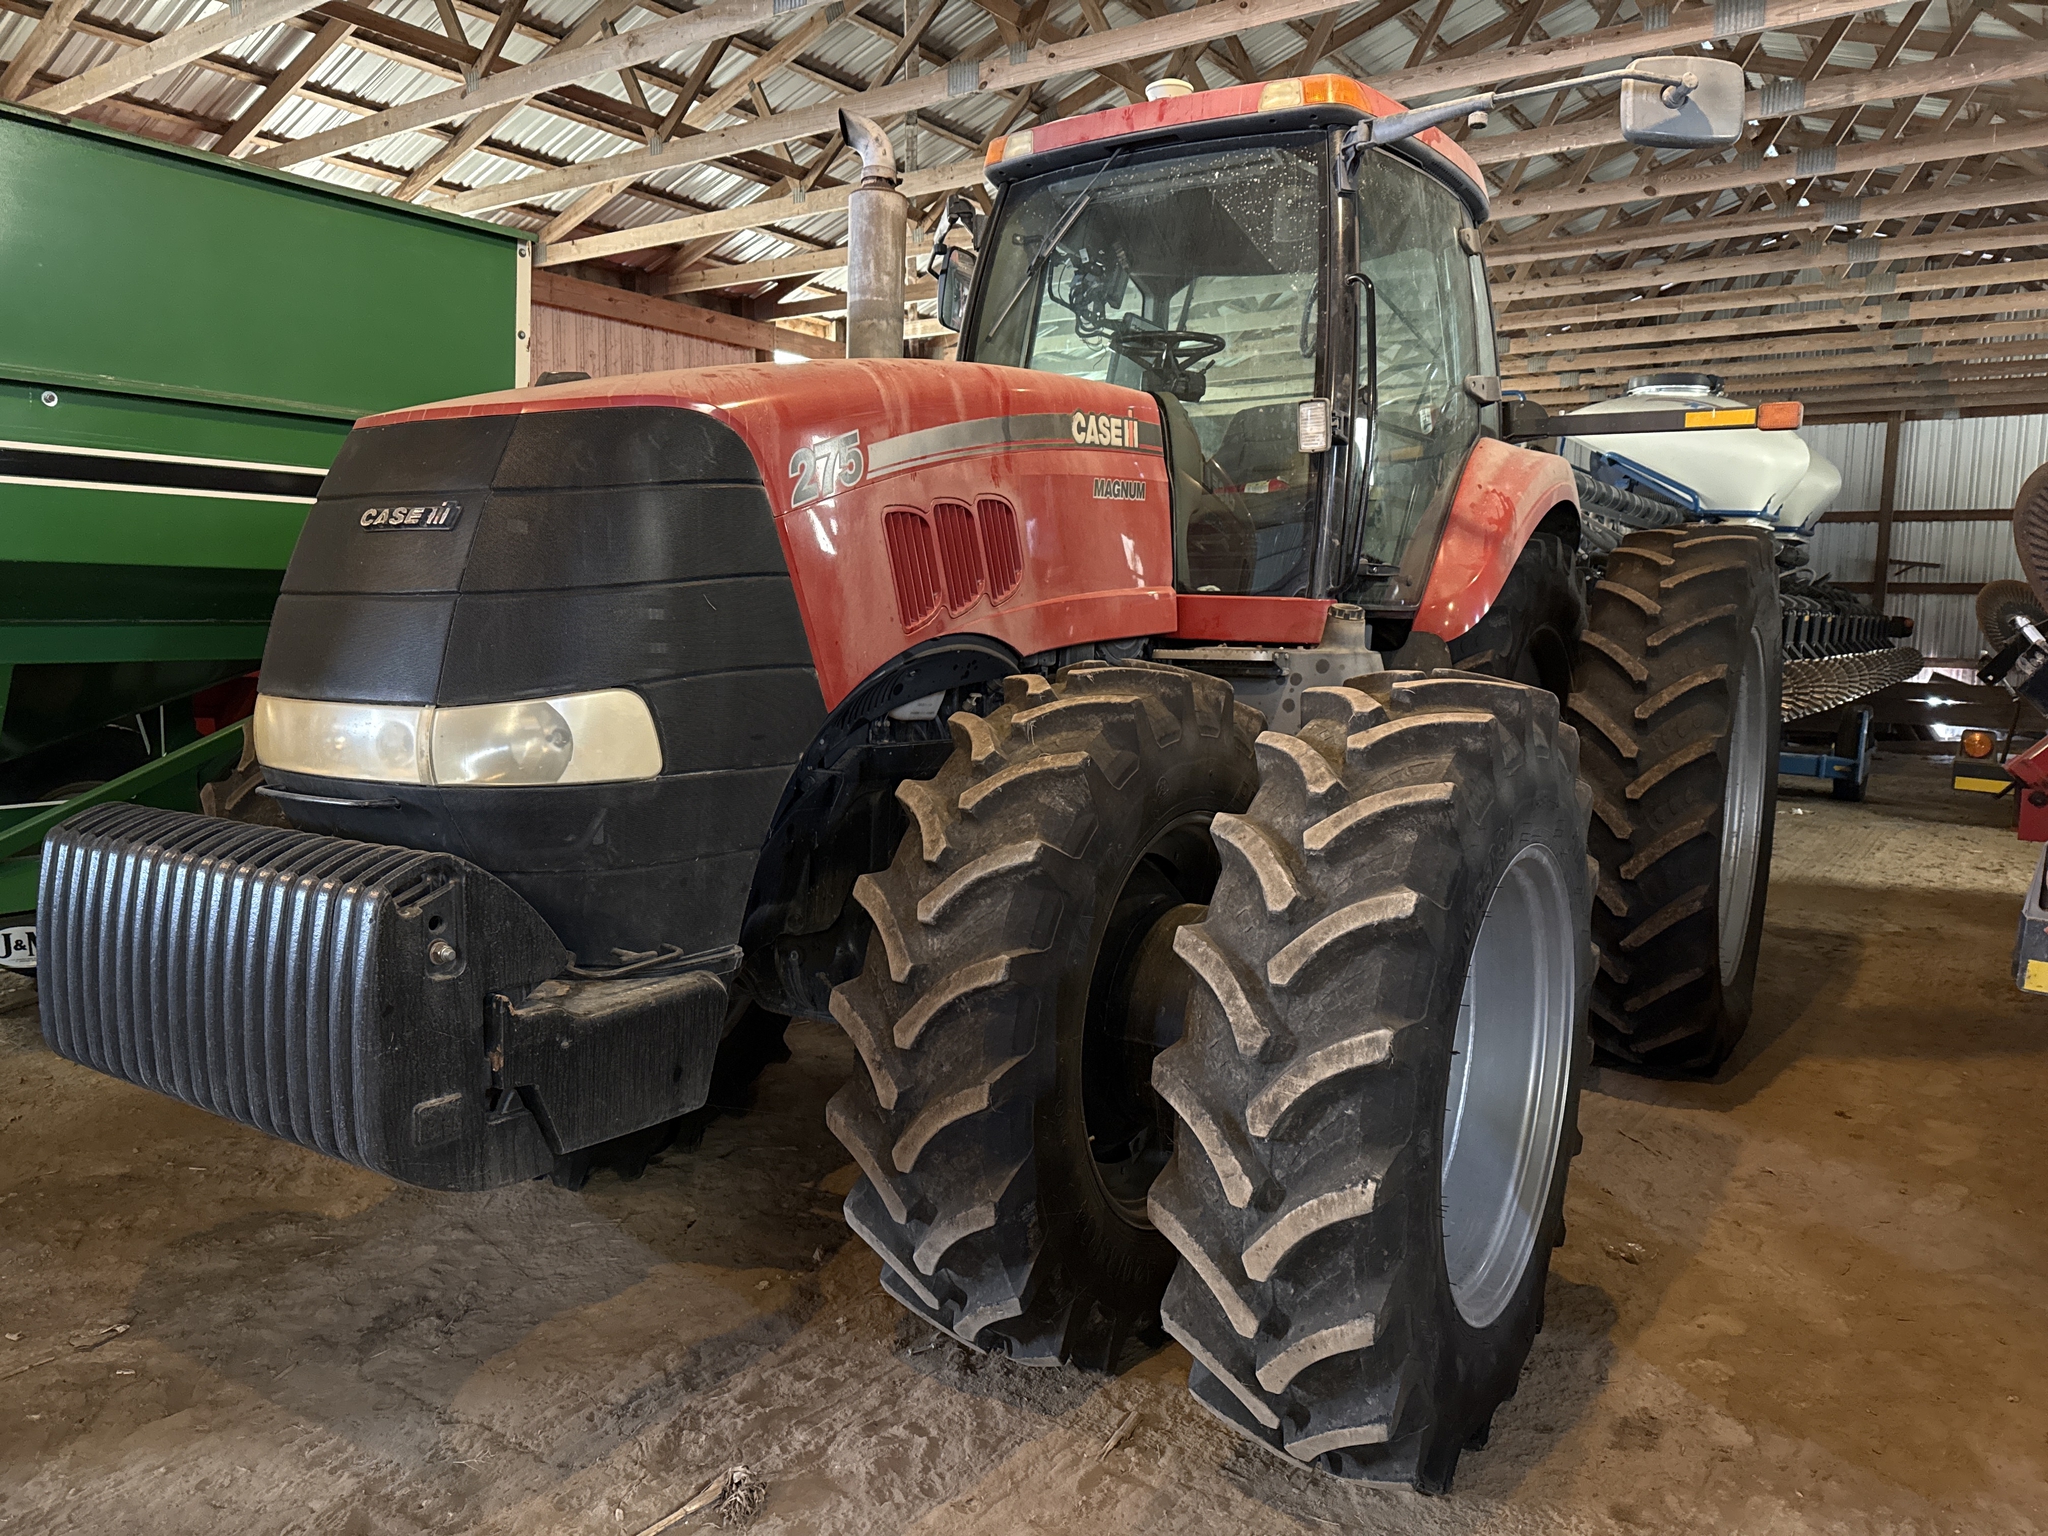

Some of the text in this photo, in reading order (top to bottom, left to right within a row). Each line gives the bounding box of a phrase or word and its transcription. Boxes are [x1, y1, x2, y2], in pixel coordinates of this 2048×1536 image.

[1071, 411, 1123, 446] CASE
[788, 429, 864, 509] 275
[1092, 477, 1147, 501] MAGNUM
[360, 506, 425, 527] CASE
